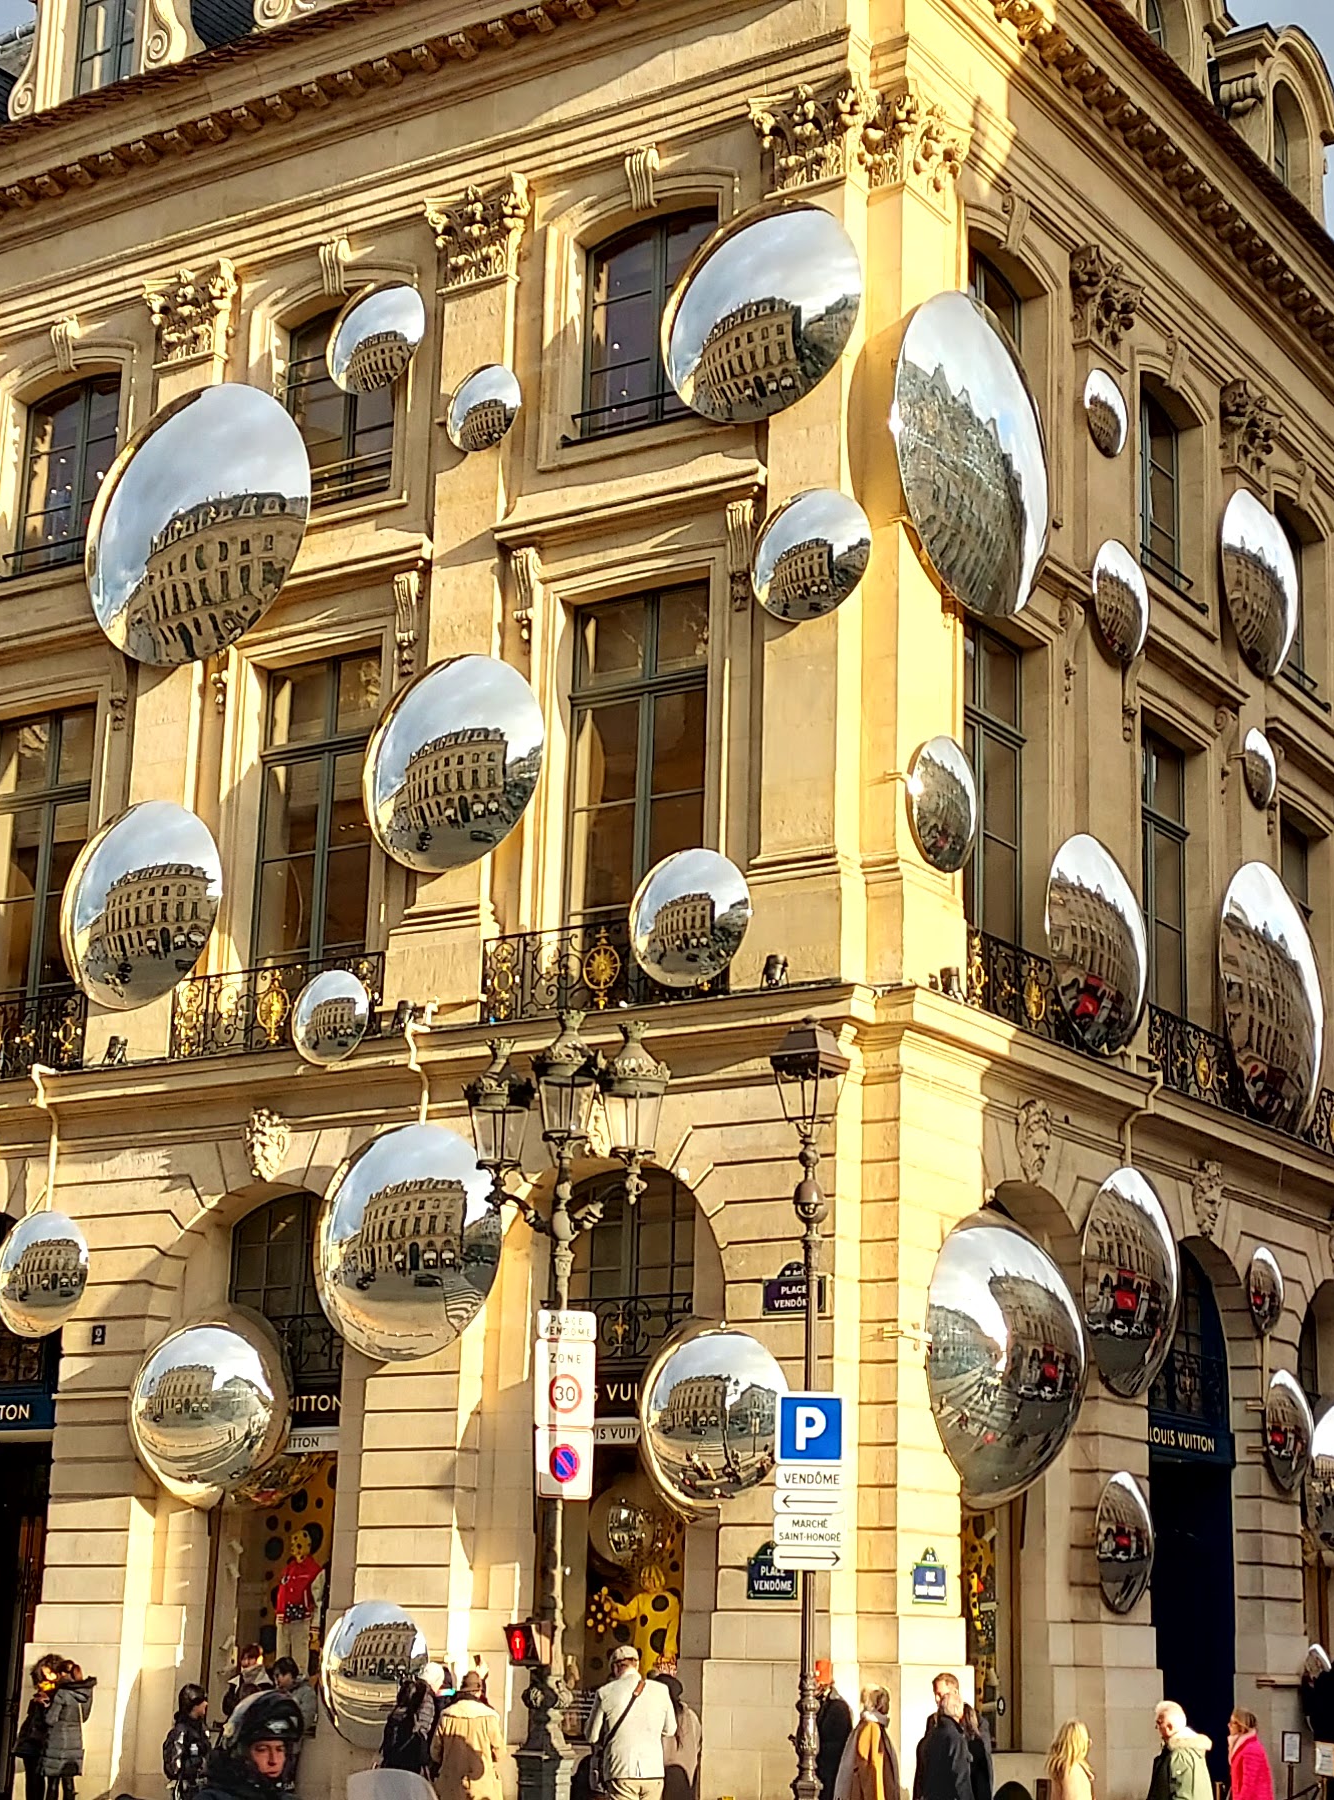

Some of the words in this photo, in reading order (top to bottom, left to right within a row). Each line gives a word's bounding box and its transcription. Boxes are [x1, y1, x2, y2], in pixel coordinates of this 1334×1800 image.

[780, 1284, 807, 1295] PLACE
[549, 1352, 582, 1364] ZONE
[554, 1385, 576, 1402] 30
[795, 1406, 827, 1451] P
[1149, 1426, 1176, 1446] LOUIS
[1177, 1431, 1215, 1453] VUITTON
[783, 1471, 841, 1485] VENDÔME
[791, 1518, 829, 1529] MARCHÉ
[760, 1565, 786, 1577] PLACE
[753, 1579, 793, 1591] VENDÔME
